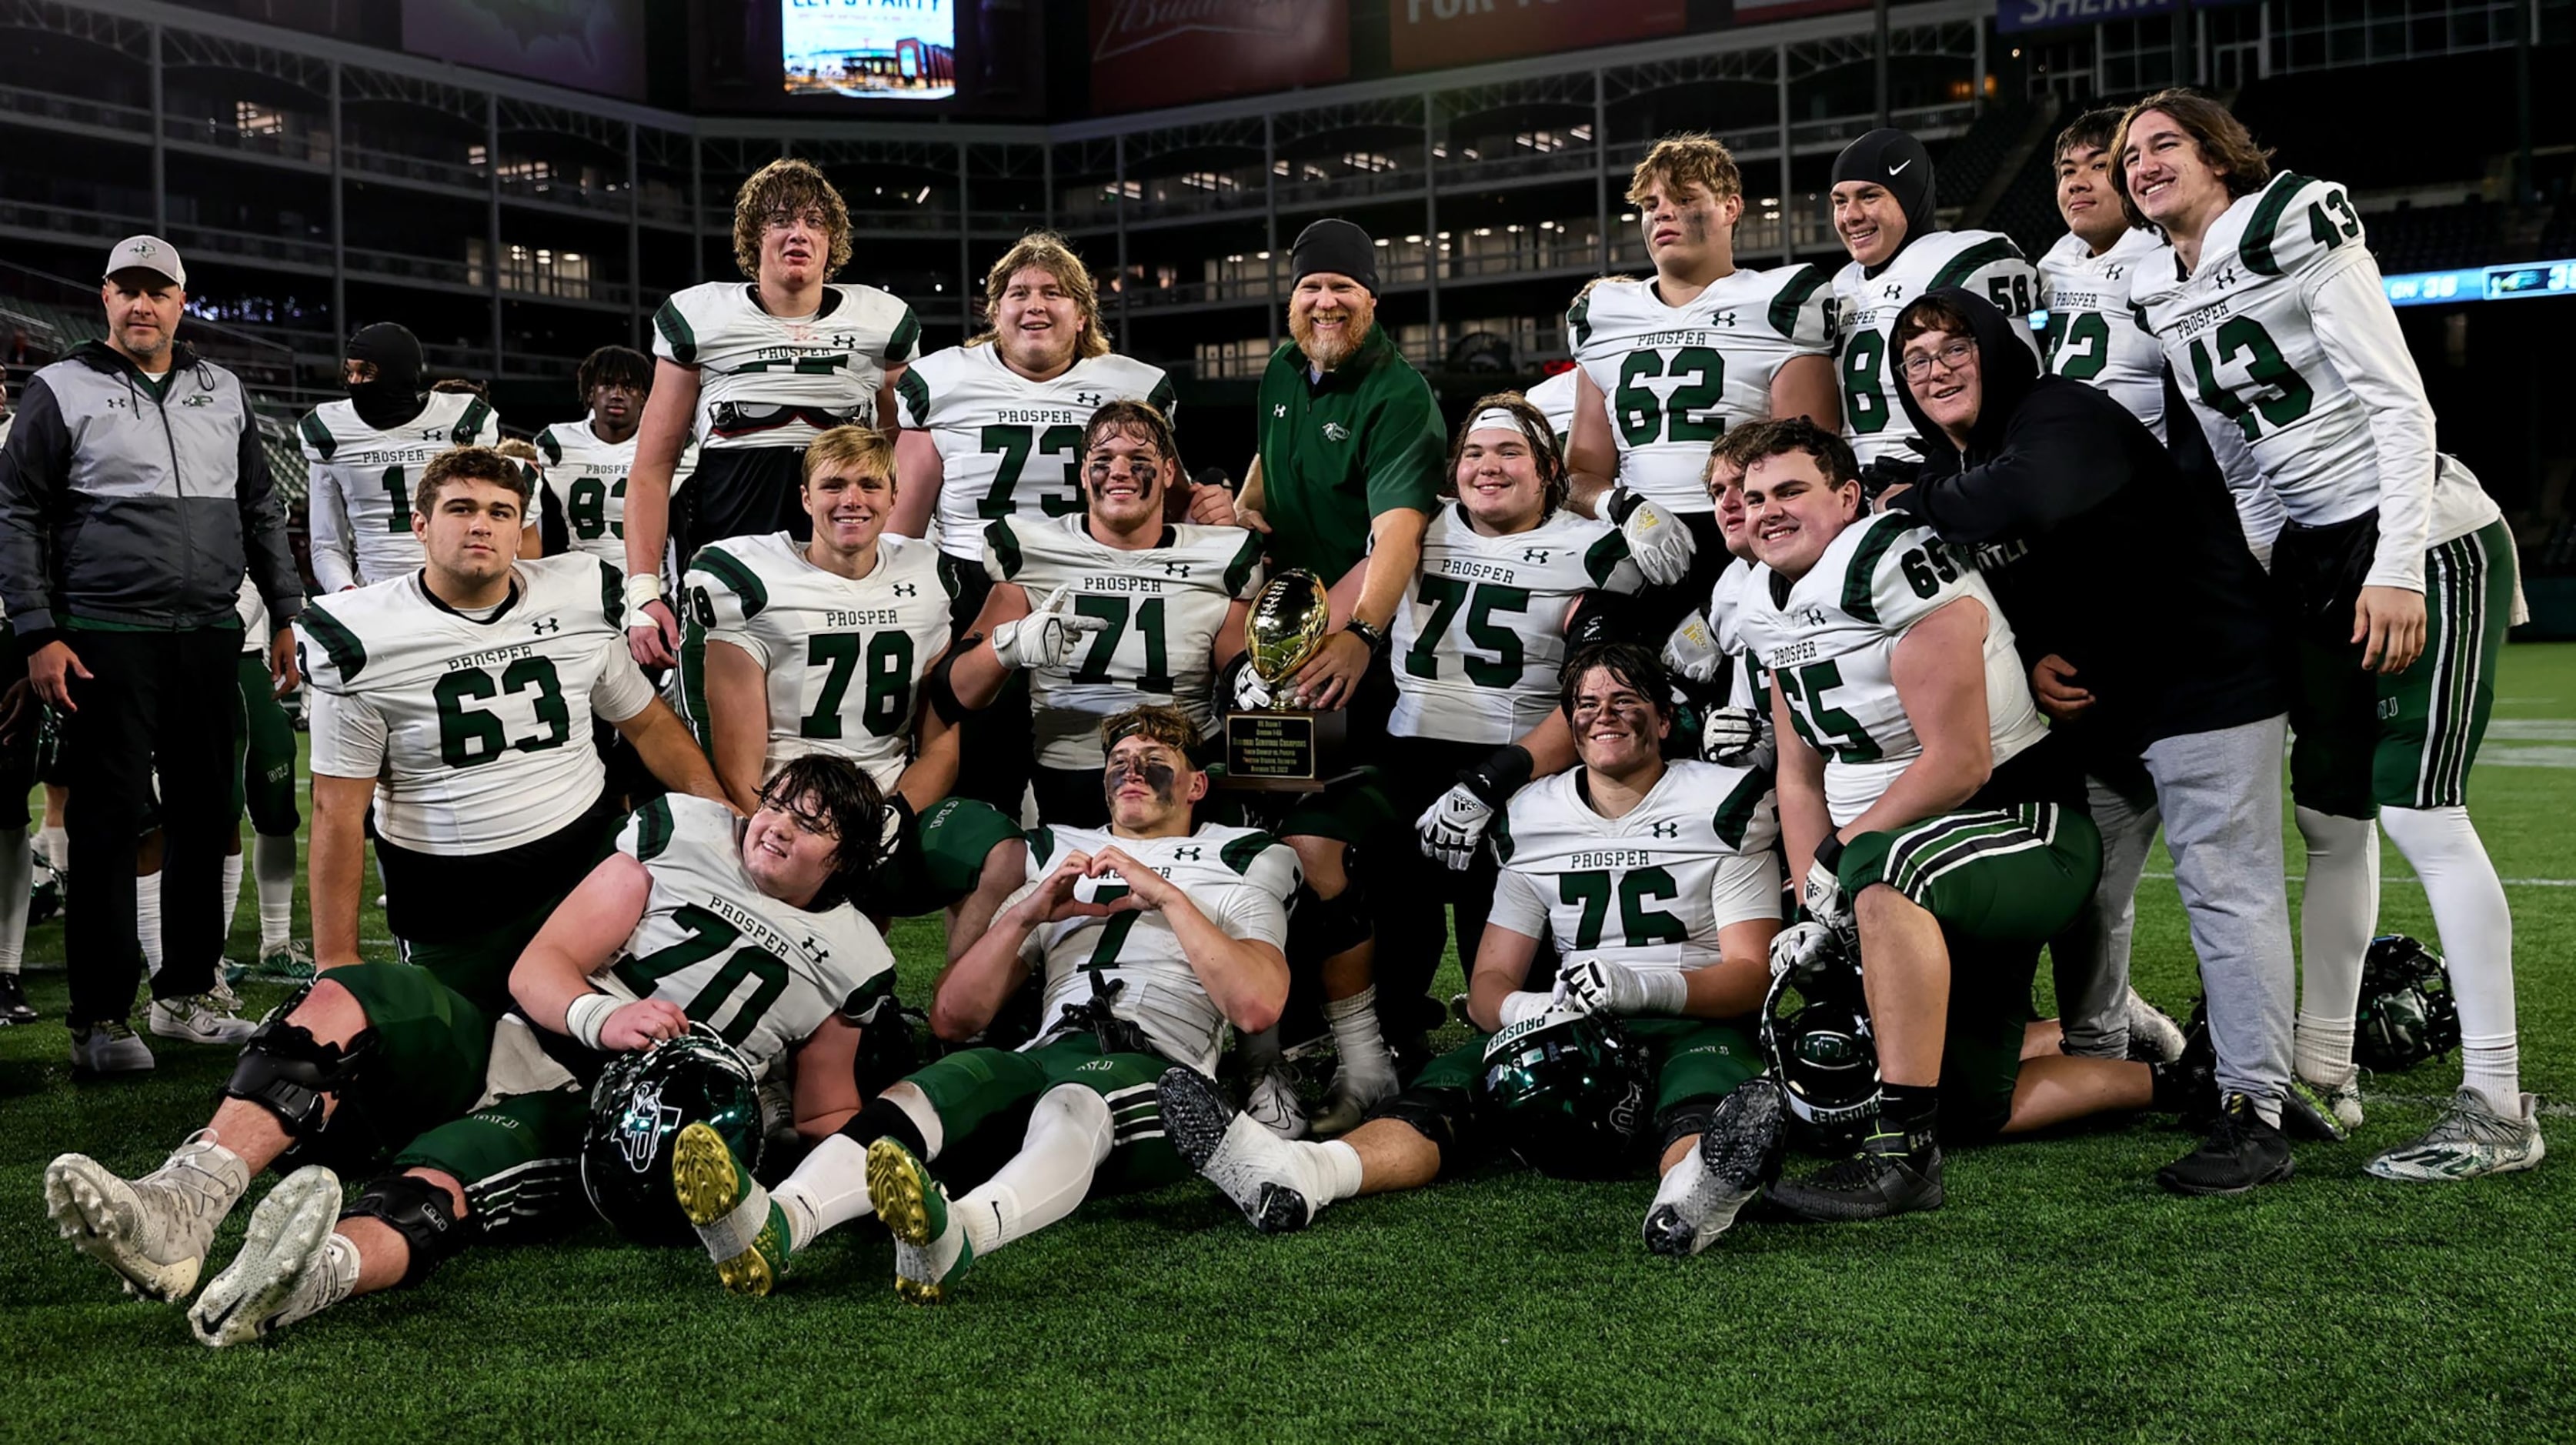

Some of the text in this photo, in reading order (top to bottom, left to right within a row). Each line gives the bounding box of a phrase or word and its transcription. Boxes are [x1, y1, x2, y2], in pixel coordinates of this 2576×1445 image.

[2308, 189, 2360, 252] 43
[1840, 310, 1877, 328] ROSPER
[1988, 274, 2031, 317] 58
[2055, 292, 2097, 309] PROSPER
[2176, 300, 2230, 339] PROSPER
[757, 346, 831, 359] PROSPER
[1637, 331, 1707, 346] PROSPER
[2044, 312, 2110, 380] 72
[1617, 348, 1725, 447] 62
[1837, 329, 1890, 435] 8
[2190, 315, 2314, 443] 43
[998, 411, 1072, 423] PROSPER
[363, 449, 425, 463] PROSPER
[586, 465, 629, 475] PROSPE
[977, 425, 1087, 519] 73
[382, 466, 413, 532] 1
[1084, 577, 1162, 592] PROSPER
[1441, 559, 1515, 584] PROSPER
[1900, 536, 1958, 599] 65
[826, 609, 899, 627] PROSPER
[1069, 595, 1175, 693] 71
[1405, 573, 1530, 689] 75
[448, 646, 533, 671] PROSPER
[800, 630, 914, 739] 78
[1774, 640, 1817, 667] PROSPER
[432, 656, 570, 769] 63
[1775, 659, 1884, 764] 65
[1570, 850, 1650, 869] PROSPER
[708, 896, 789, 957] PROSPER
[1076, 885, 1142, 973] 7
[1559, 866, 1690, 951] 76
[611, 902, 789, 1048] 70
